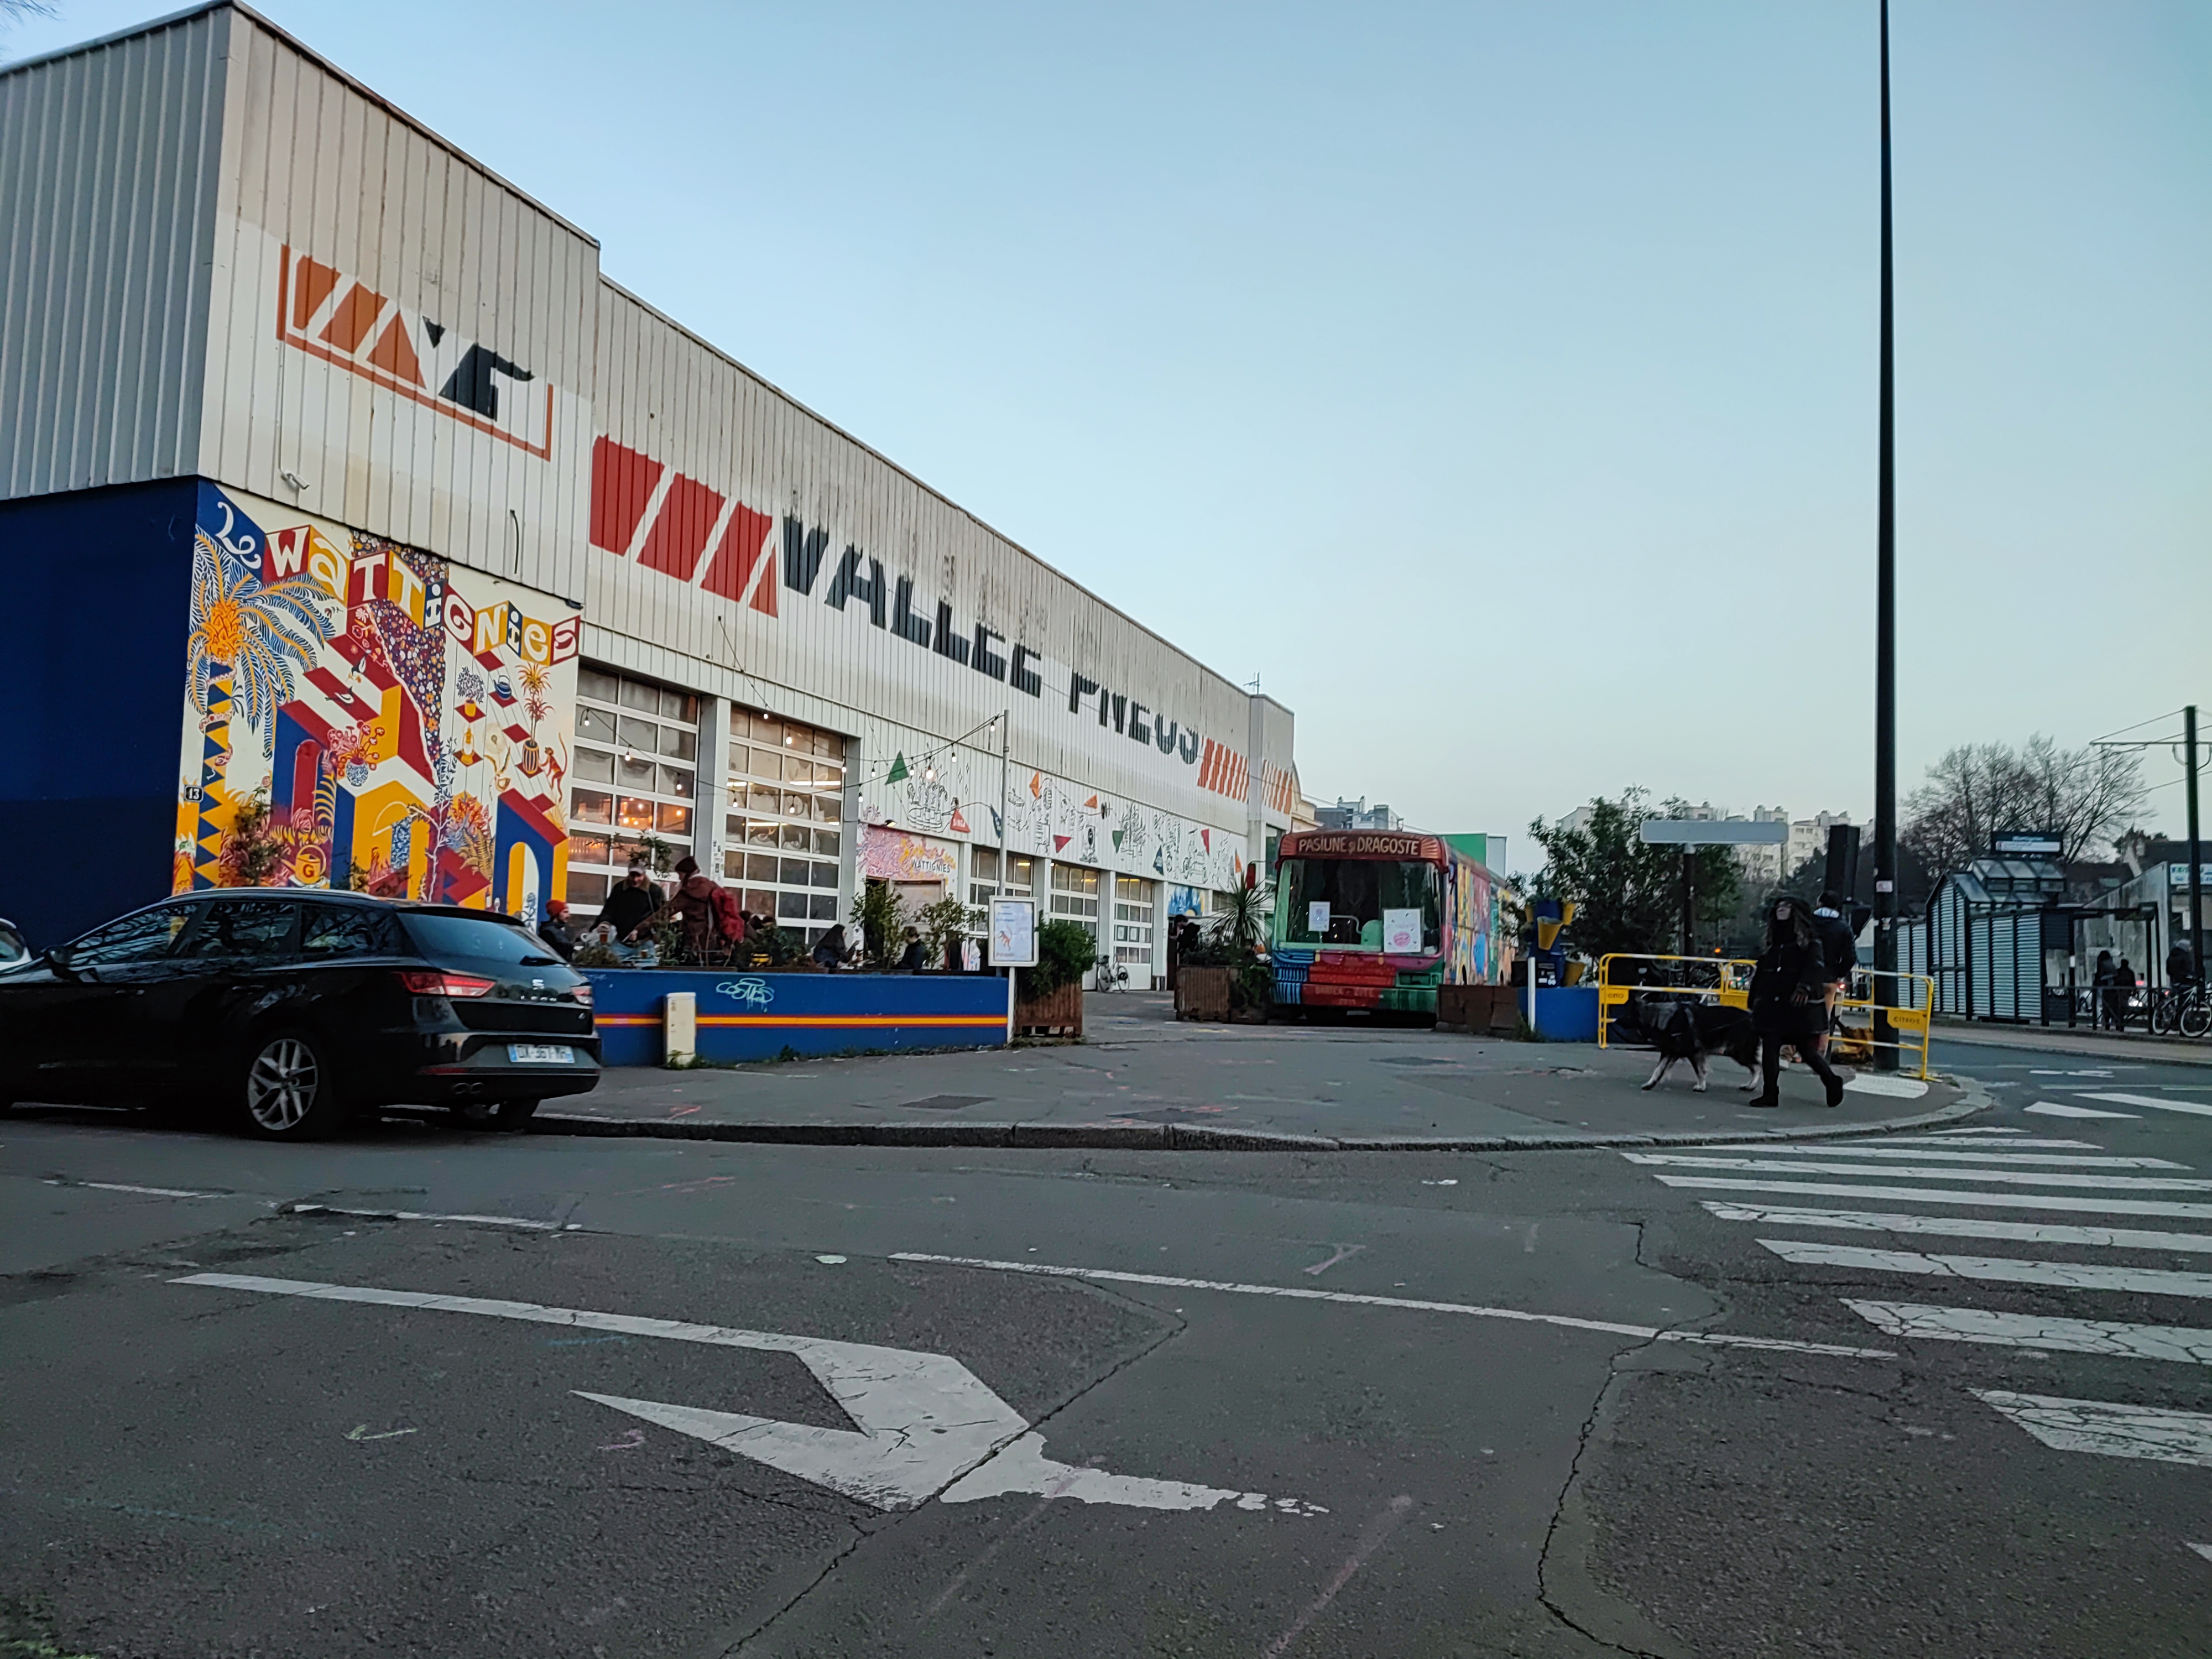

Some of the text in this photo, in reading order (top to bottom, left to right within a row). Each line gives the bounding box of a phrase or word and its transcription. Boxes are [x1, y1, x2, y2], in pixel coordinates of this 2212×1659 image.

[215, 501, 262, 570] Le
[782, 509, 1042, 698] VALLEE
[188, 787, 200, 800] 13
[1357, 836, 1420, 855] DRAGOSTE
[302, 864, 315, 878] G
[911, 858, 951, 873] WATTIGNIES
